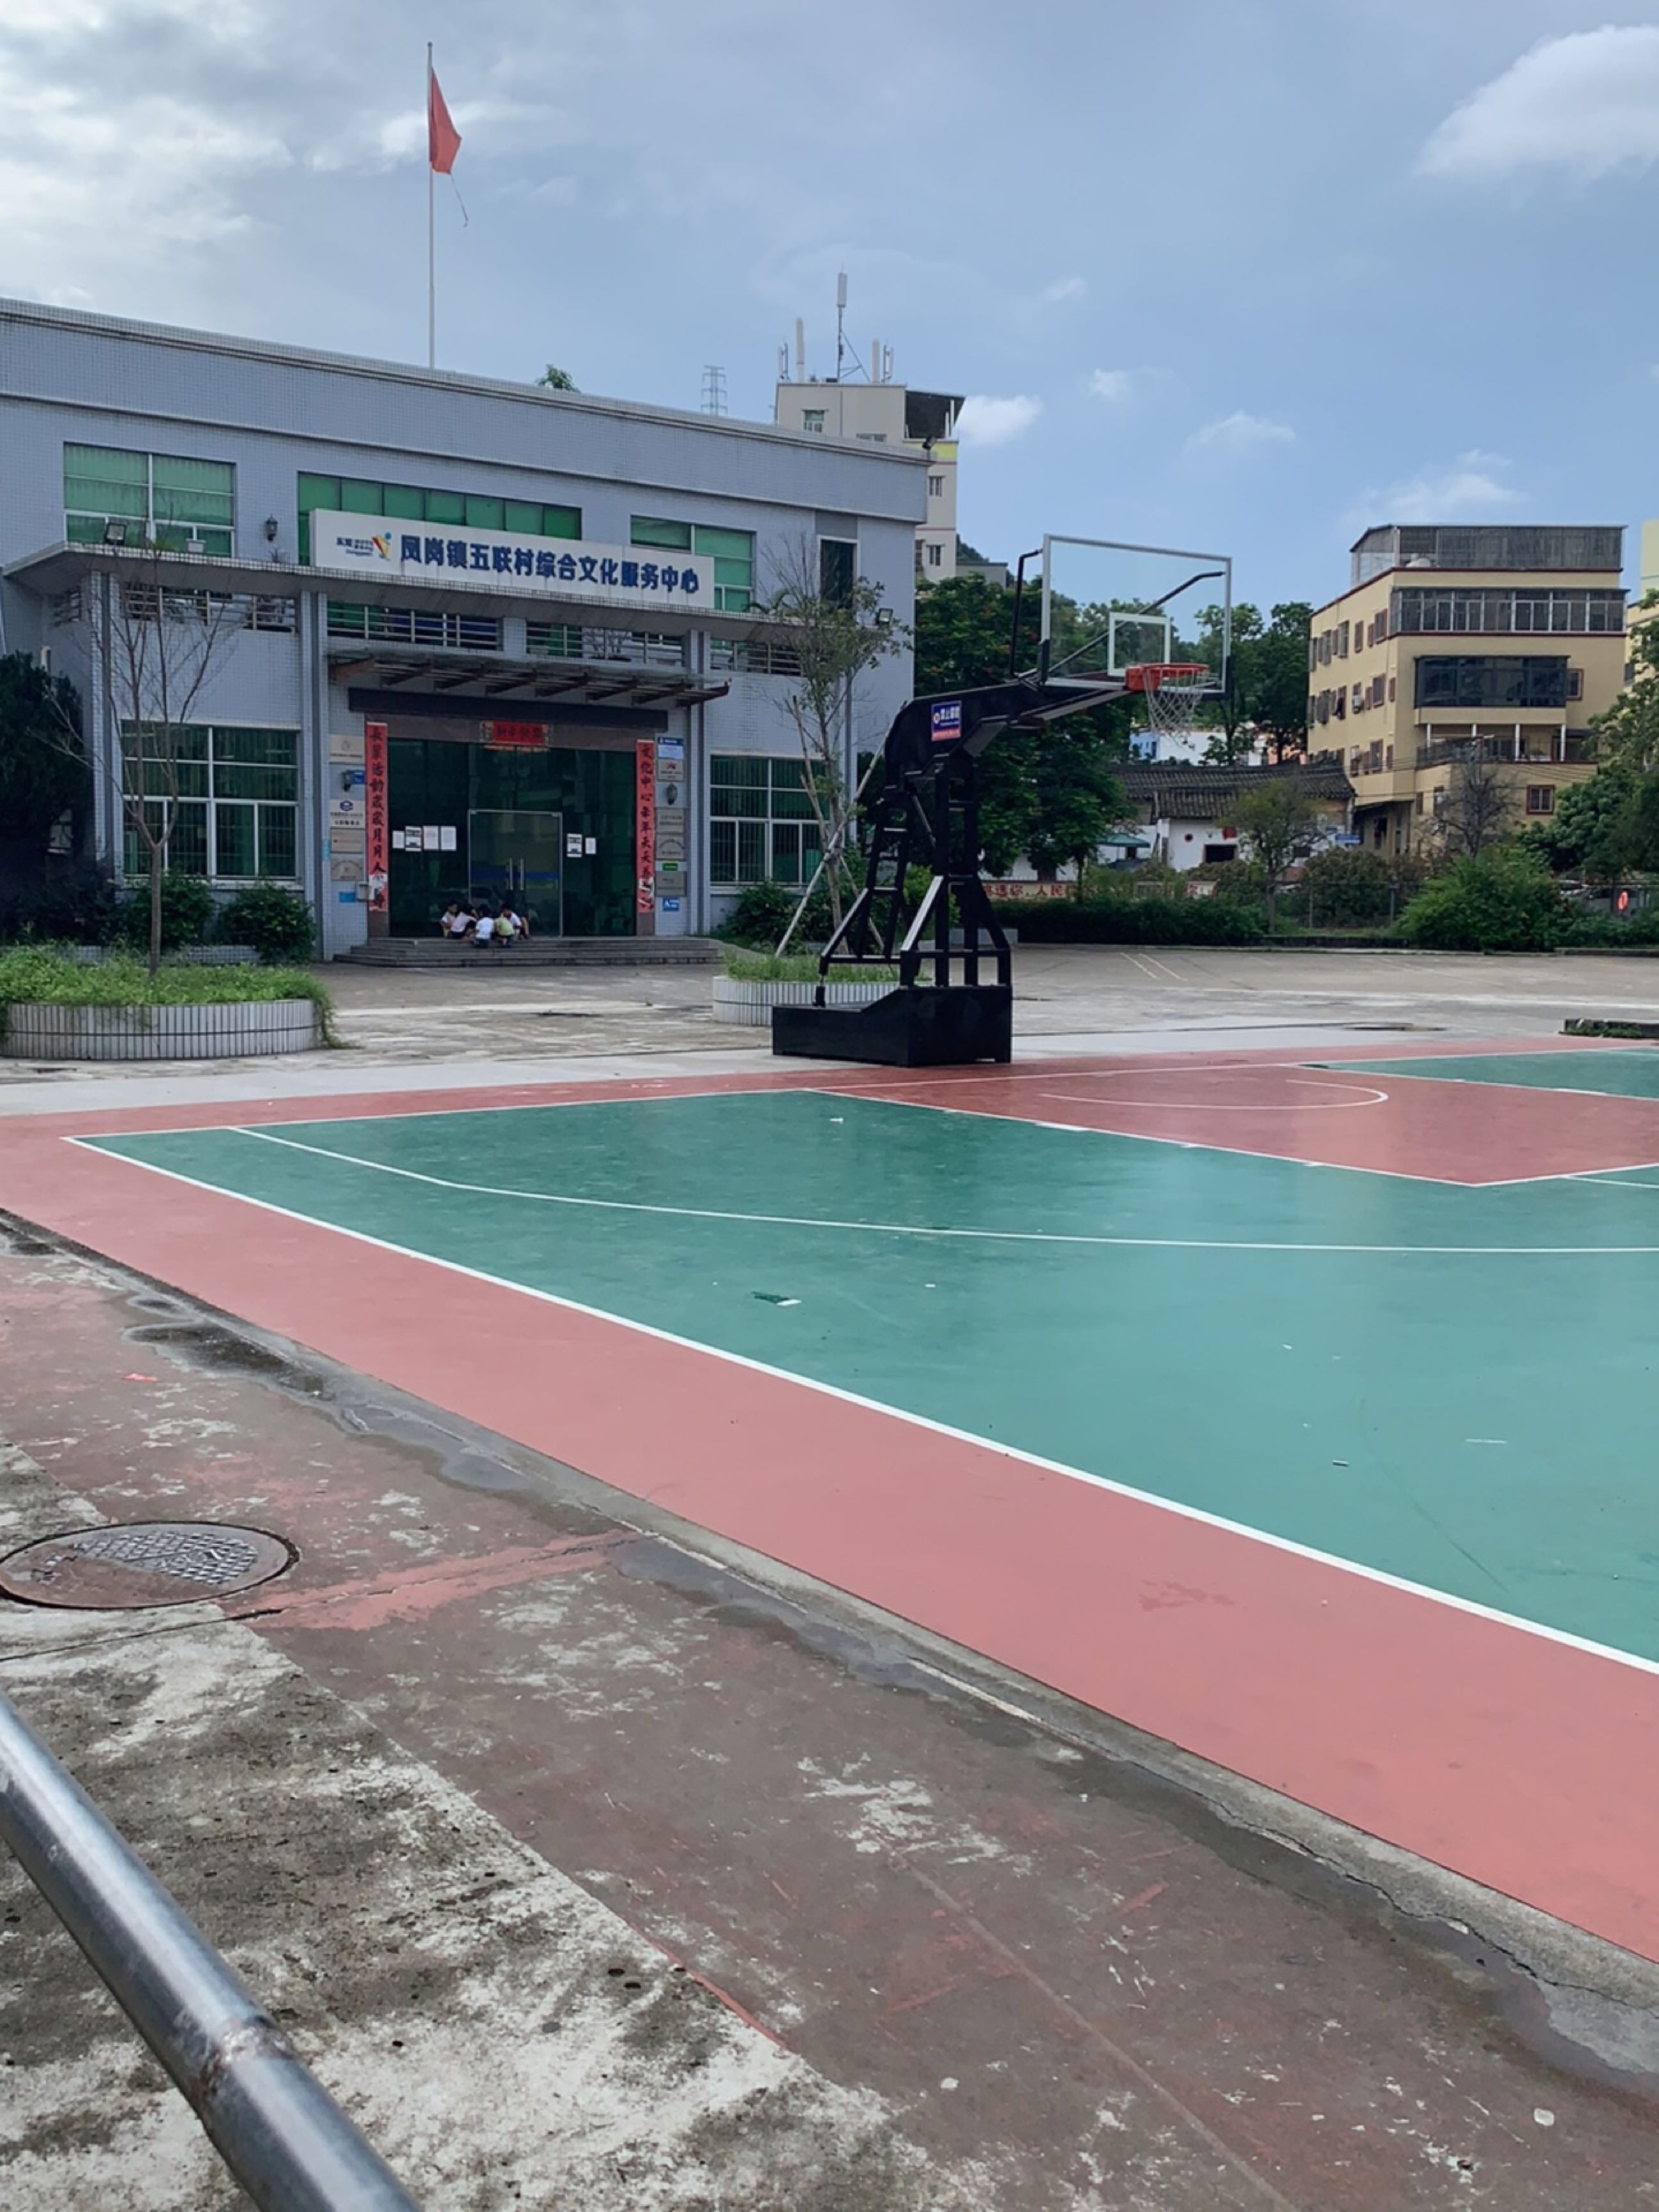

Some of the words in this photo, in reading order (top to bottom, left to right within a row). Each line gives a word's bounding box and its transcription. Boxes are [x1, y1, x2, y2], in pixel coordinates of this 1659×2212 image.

[401, 534, 699, 594] 凤岗镇五联村综合文化服务中心
